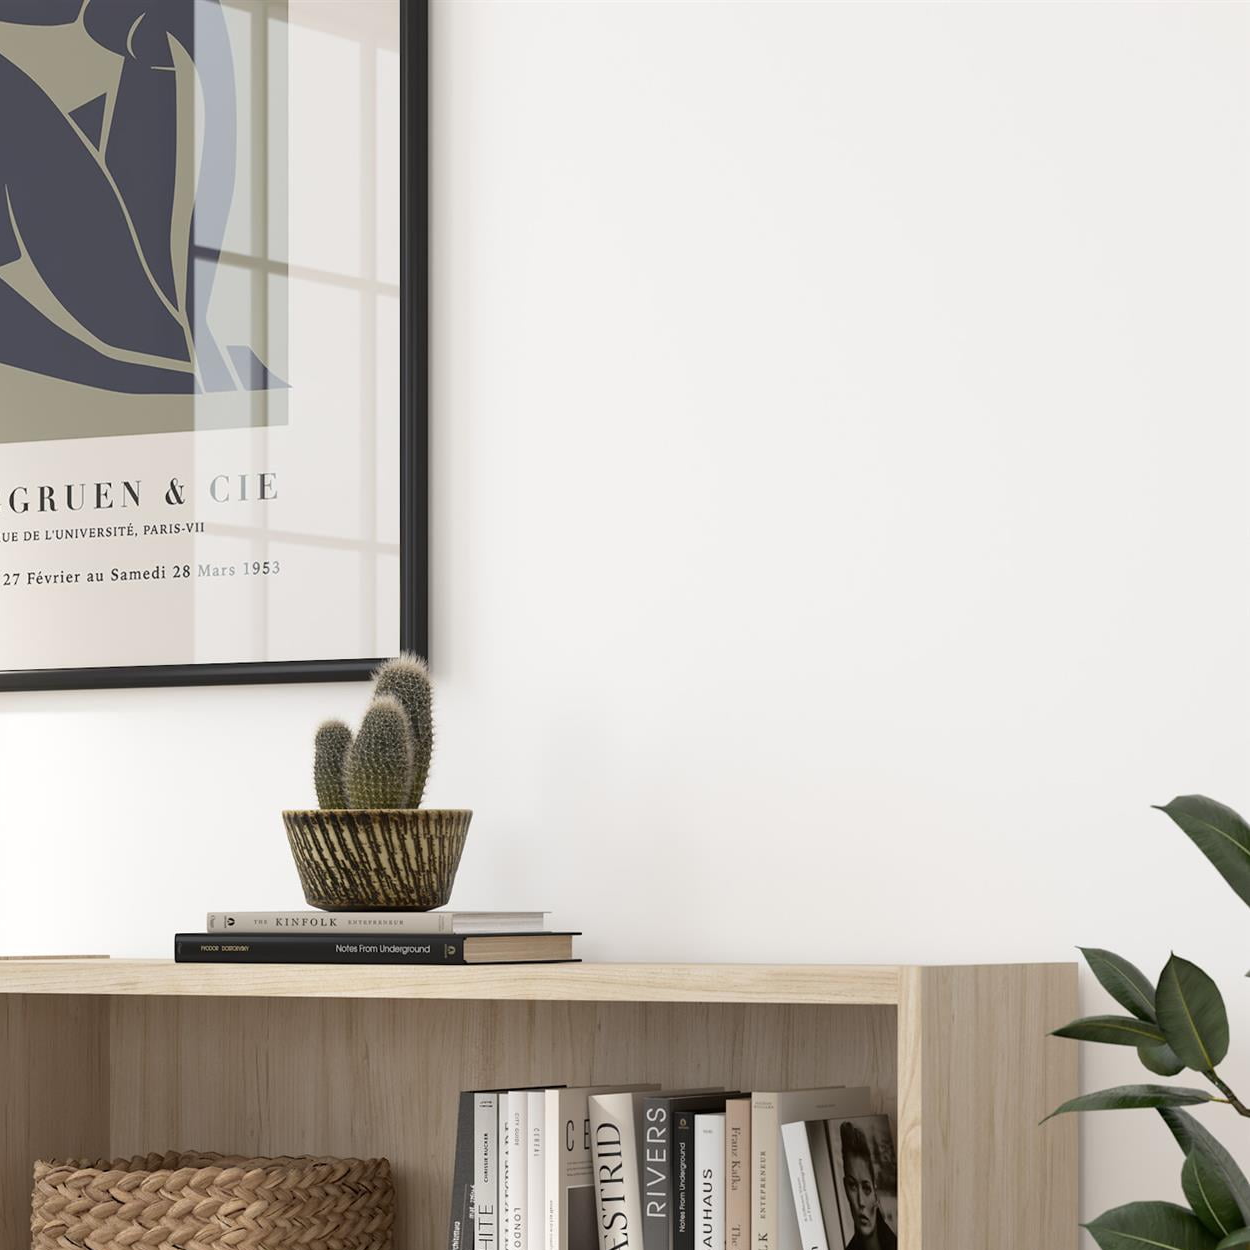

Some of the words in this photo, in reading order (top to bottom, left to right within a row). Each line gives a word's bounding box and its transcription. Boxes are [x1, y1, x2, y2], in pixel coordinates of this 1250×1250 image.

[165, 477, 186, 506] &
[209, 472, 278, 503] CIE
[23, 531, 40, 541] DE
[44, 523, 139, 541] L'UNIVERSITÉ,
[143, 521, 205, 537] PARIS-VII
[3, 572, 20, 586] 27
[27, 568, 81, 585] Février
[87, 571, 105, 582] au
[110, 566, 166, 582] Samedi
[173, 565, 191, 579] 28
[198, 564, 235, 578] Mars
[243, 561, 281, 576] 1953
[276, 917, 338, 927] KINFOLK
[335, 944, 357, 953] Notes
[358, 944, 378, 953] From
[379, 944, 430, 955] Underground
[732, 1127, 742, 1158] Franz
[647, 1107, 666, 1218] RIVERS
[679, 1142, 687, 1190] Underground
[732, 1160, 742, 1191] Kafka
[732, 1224, 742, 1246] The
